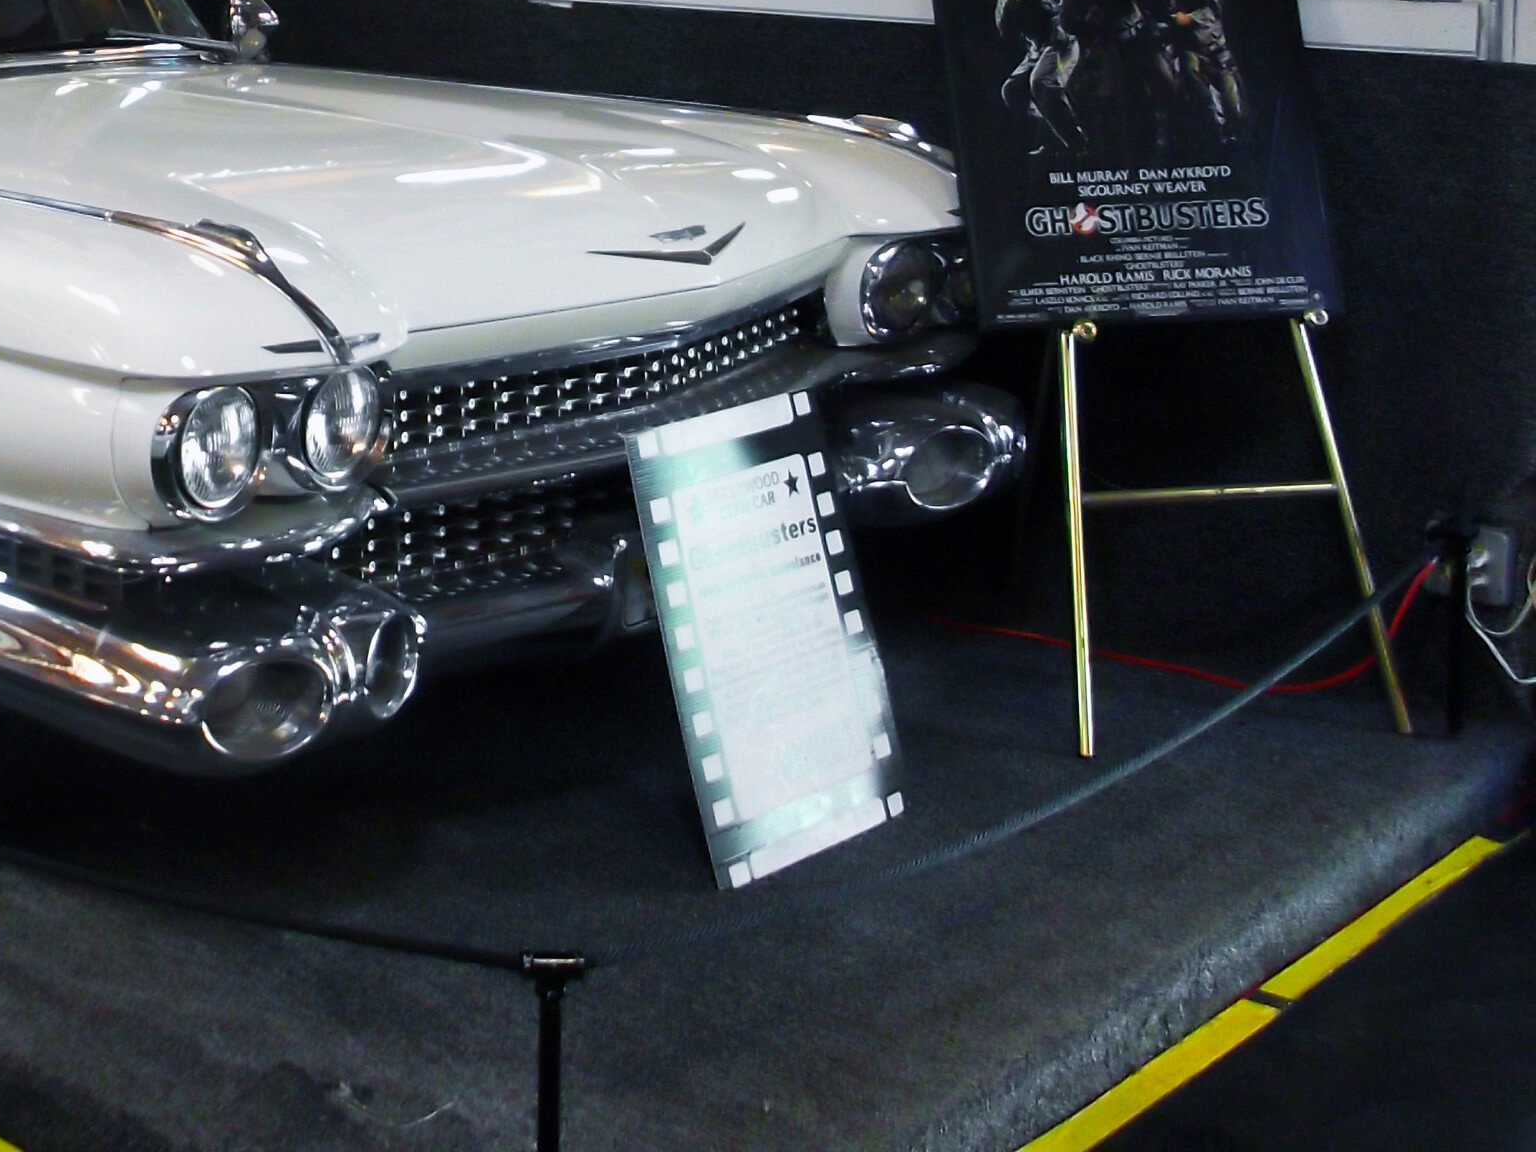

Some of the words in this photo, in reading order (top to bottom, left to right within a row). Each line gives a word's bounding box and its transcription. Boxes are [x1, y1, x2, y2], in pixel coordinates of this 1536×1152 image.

[1049, 172, 1074, 184] BILL
[1077, 169, 1129, 183] MURRAY
[1139, 167, 1168, 180] DAN
[1171, 165, 1231, 178] AYKROYD
[1078, 184, 1150, 197] SIGOURNEY
[1154, 181, 1206, 194] WEAVER
[1059, 272, 1113, 285] HAROLD
[1116, 270, 1155, 283] RAMIS
[1163, 269, 1191, 281] RICK
[1195, 266, 1252, 279] MORANIS
